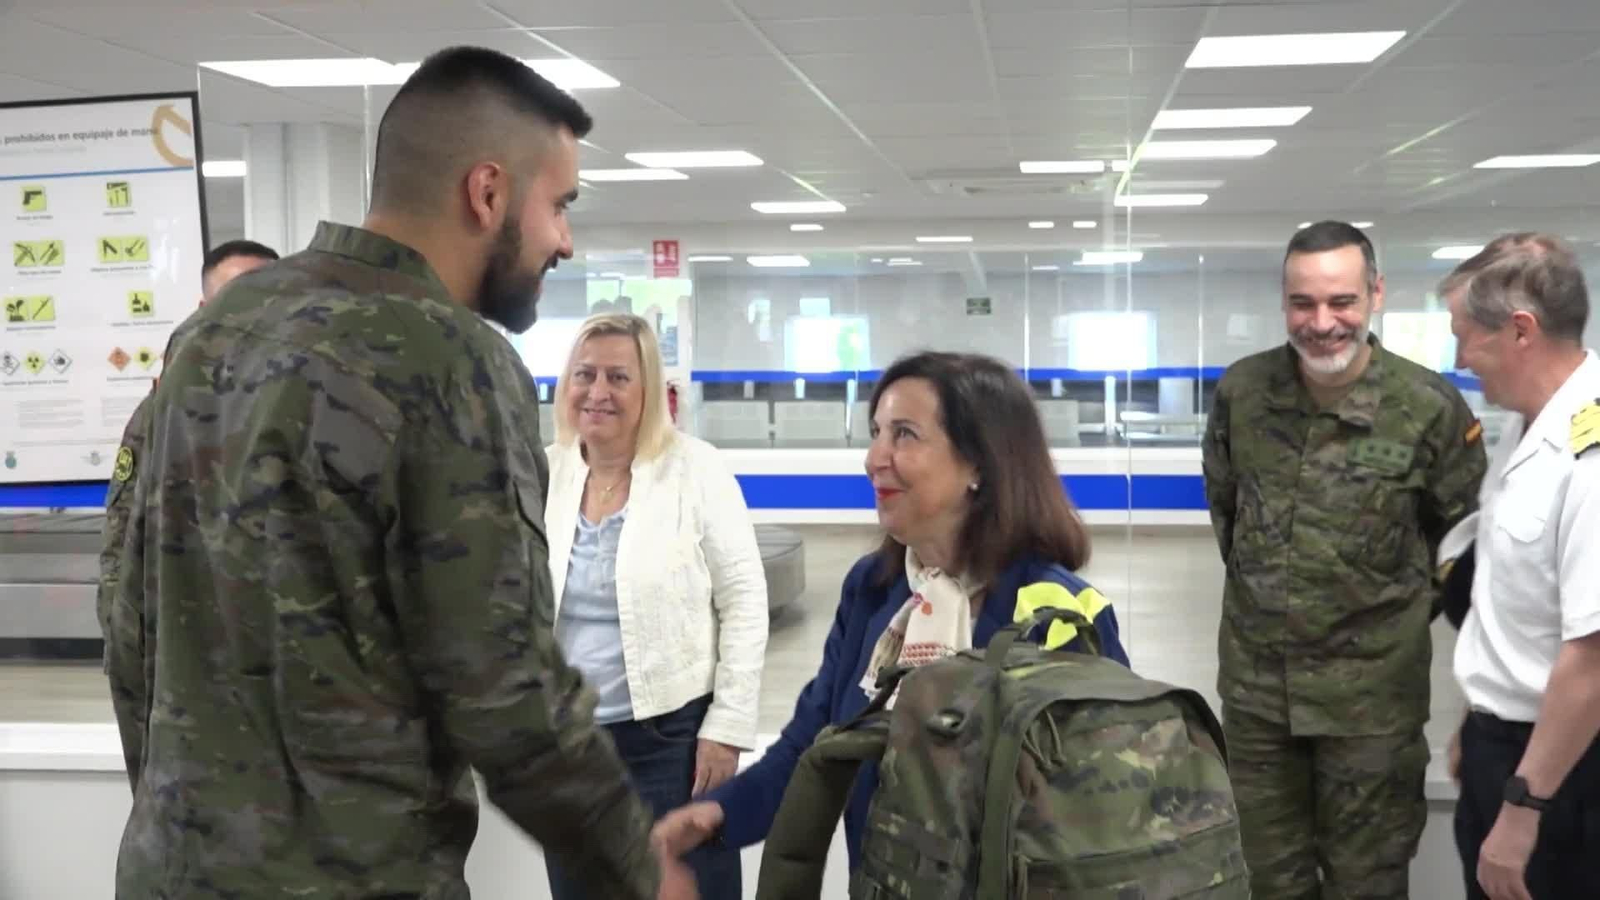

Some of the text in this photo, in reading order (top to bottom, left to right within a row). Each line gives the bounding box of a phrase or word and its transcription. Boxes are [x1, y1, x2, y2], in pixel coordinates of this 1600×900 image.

[4, 132, 56, 145] prohibidos
[58, 132, 71, 141] en
[72, 128, 114, 142] equipaje
[116, 126, 129, 138] de
